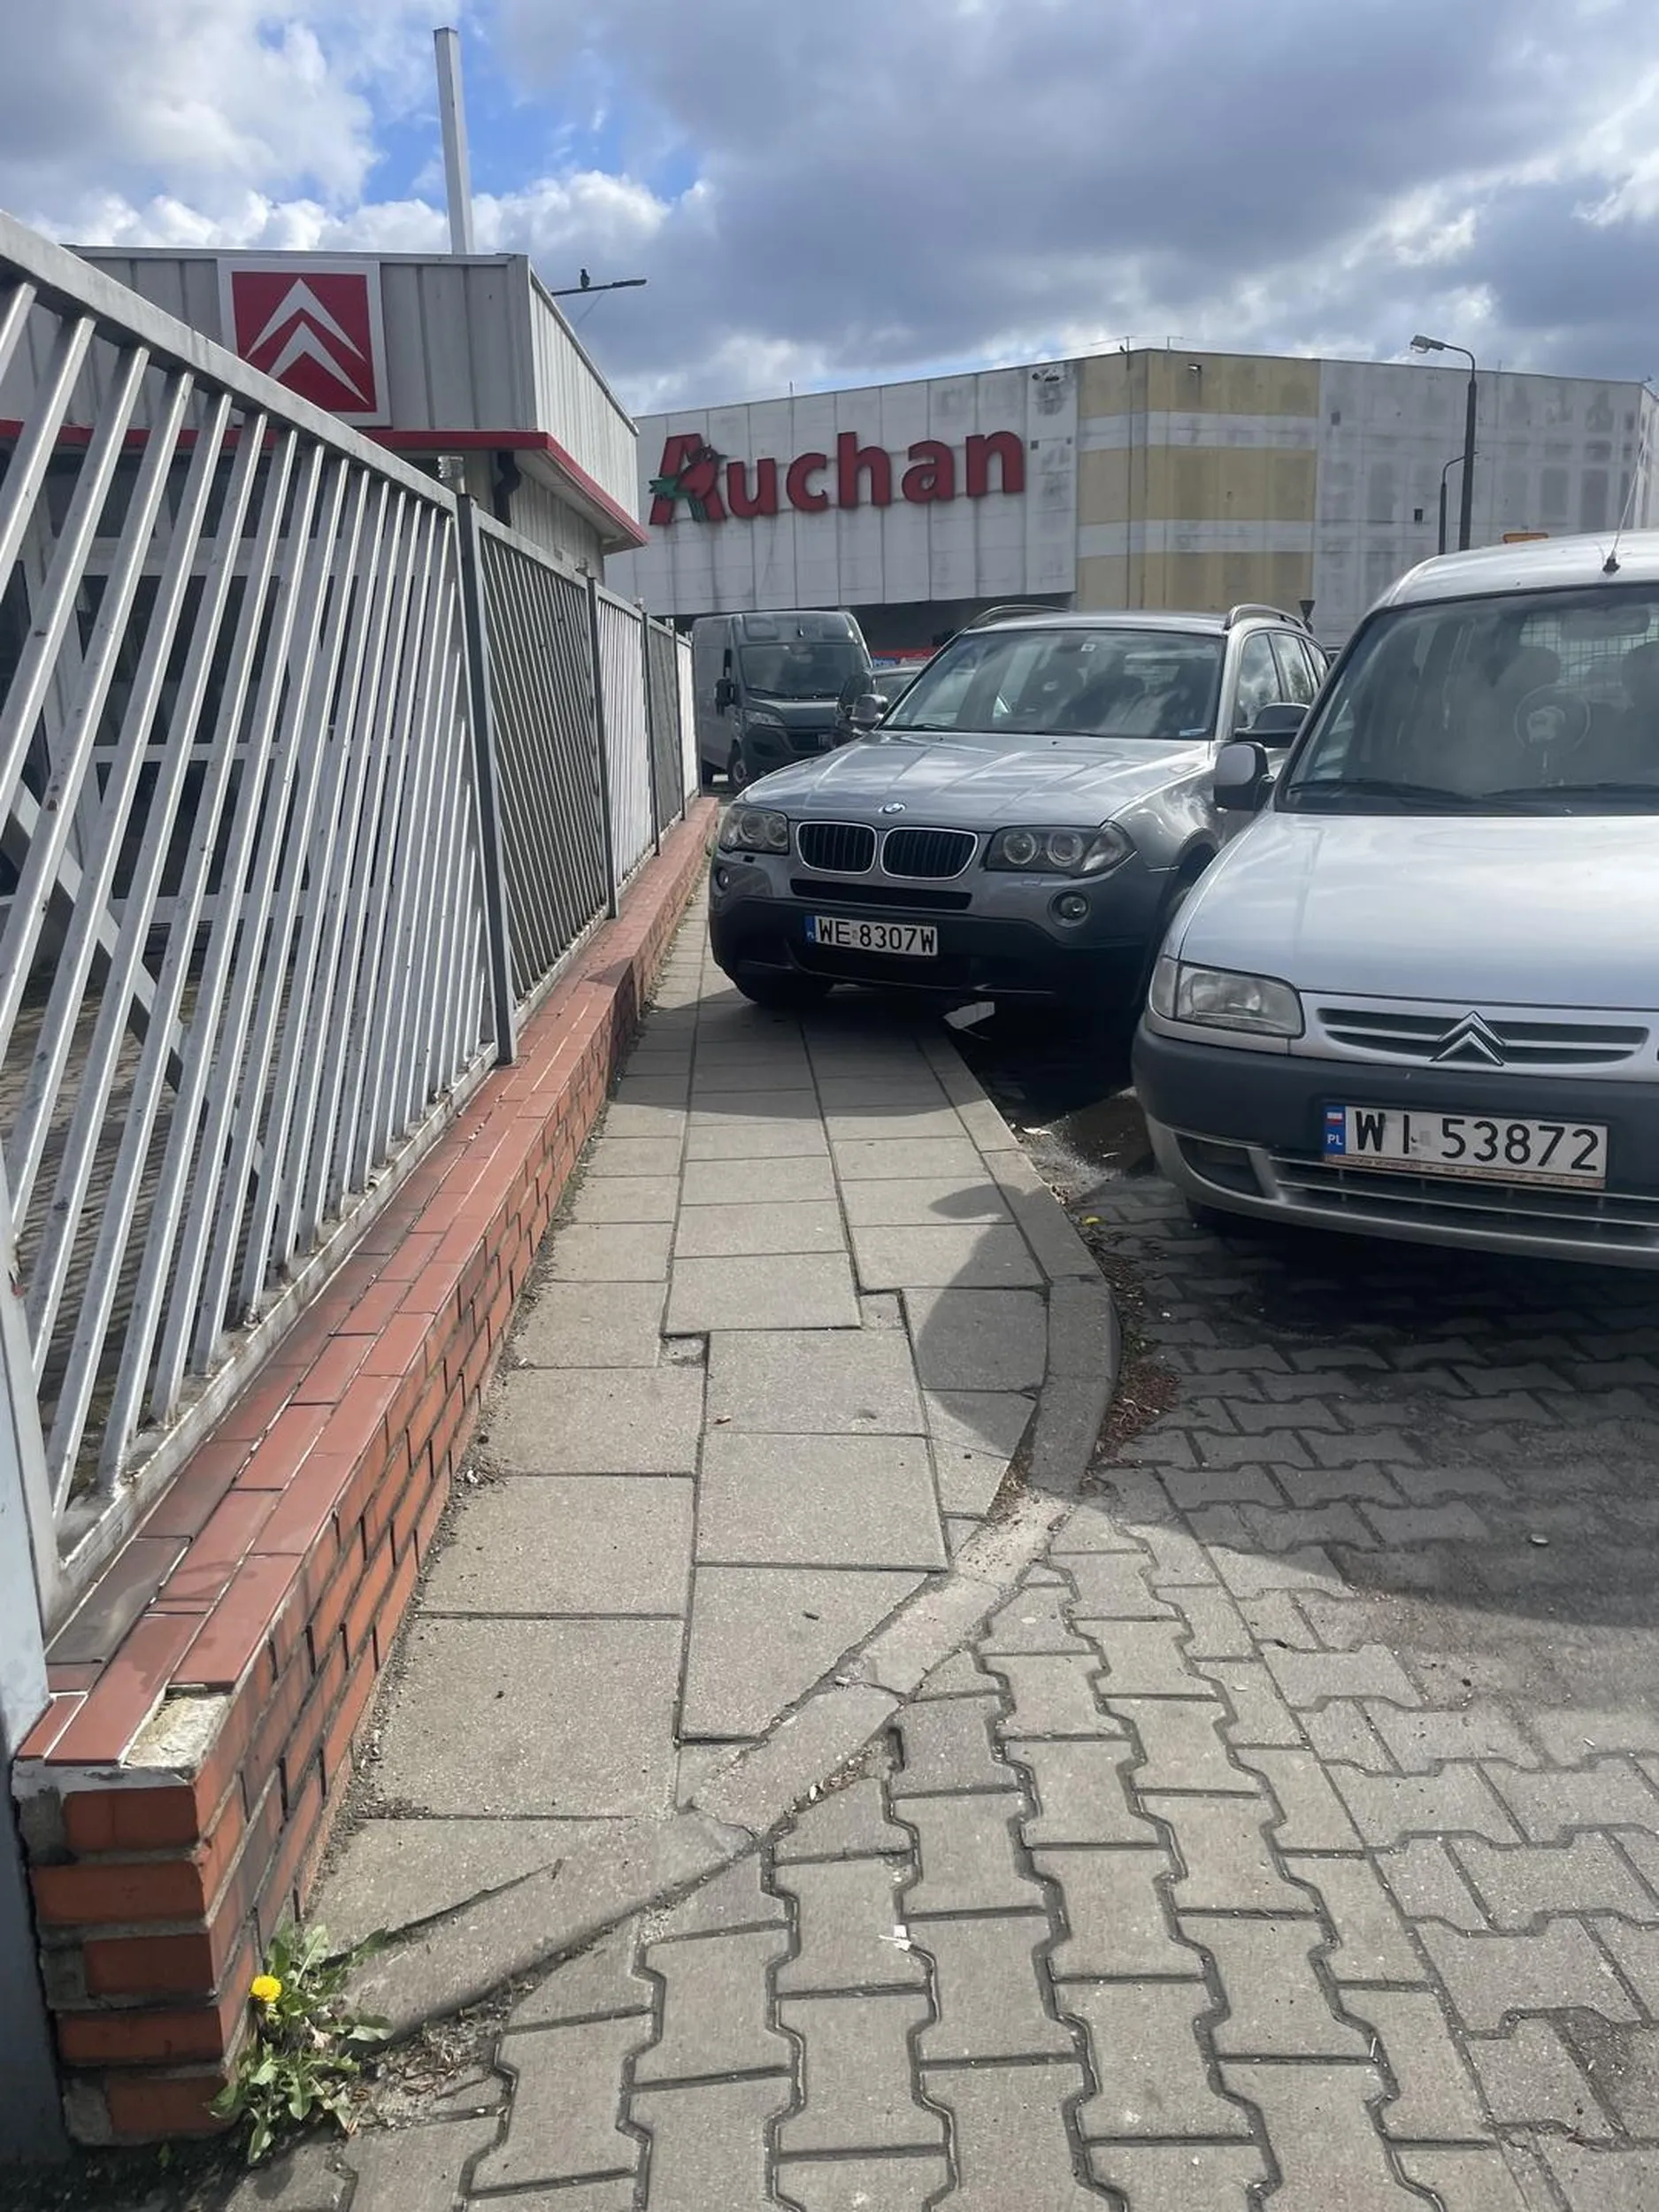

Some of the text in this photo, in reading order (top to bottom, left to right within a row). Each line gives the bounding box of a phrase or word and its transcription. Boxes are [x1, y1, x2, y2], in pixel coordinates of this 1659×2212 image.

[649, 431, 1025, 525] Auchan
[818, 918, 935, 953] WE 8307W
[1327, 1133, 1343, 1146] PL
[1355, 1110, 1599, 1171] WI 53872
